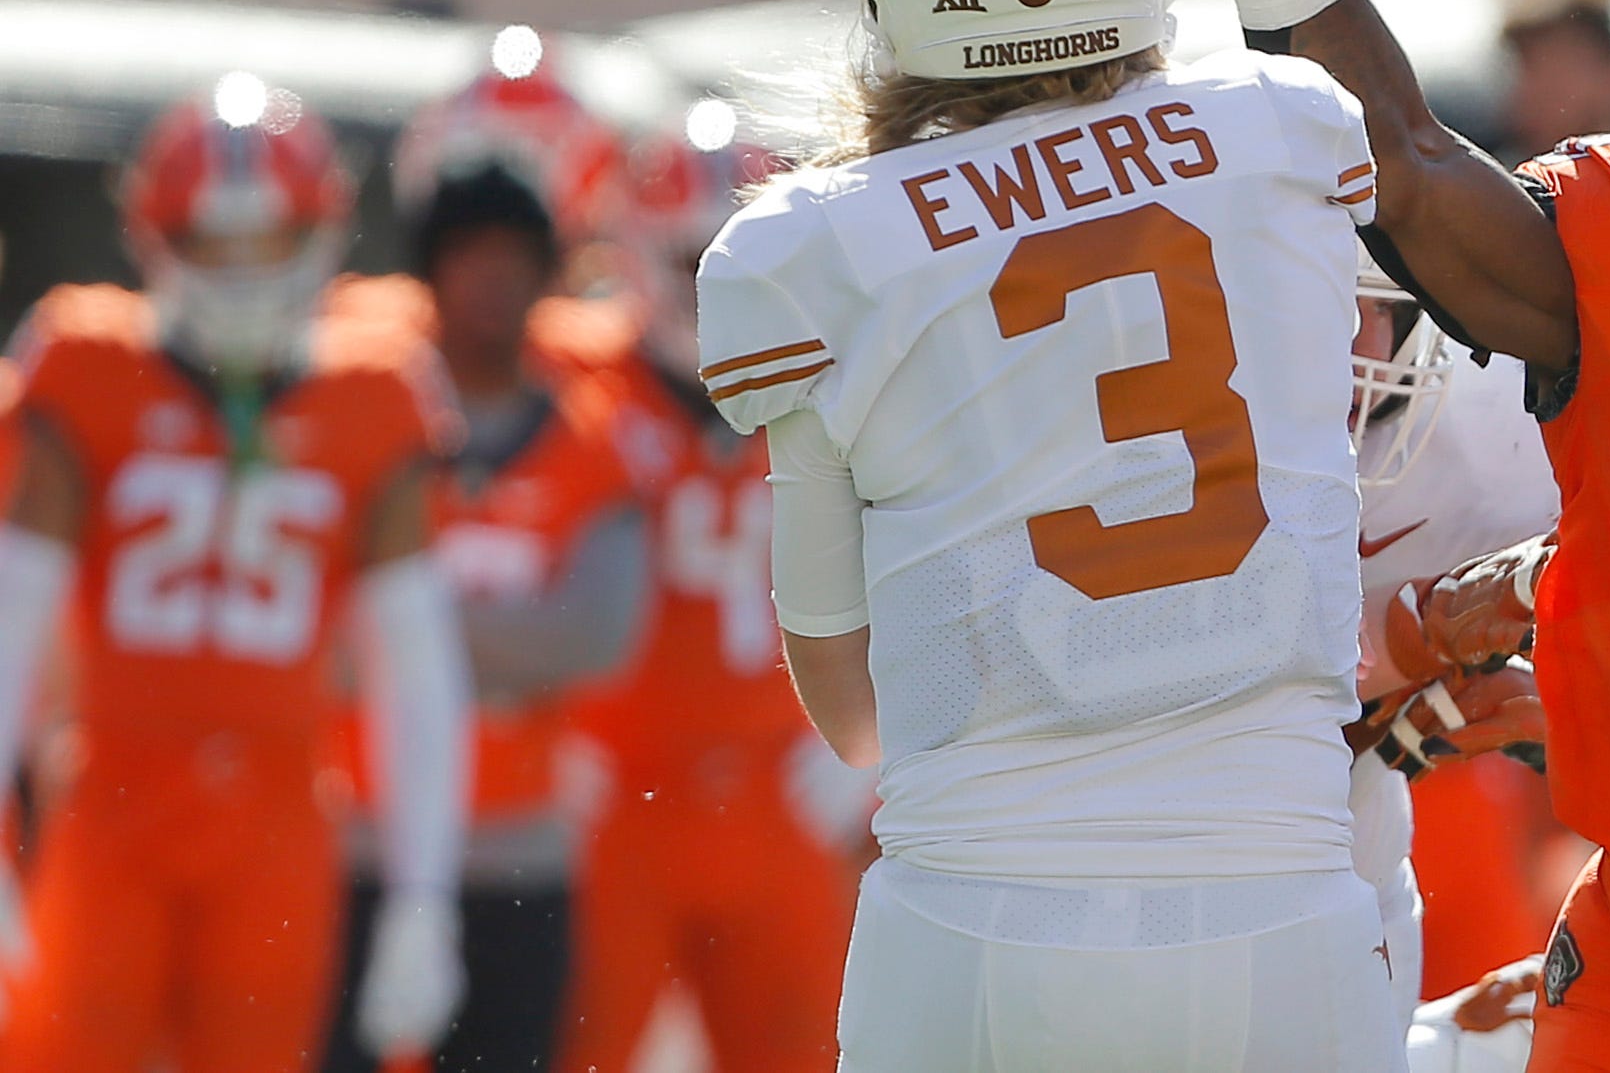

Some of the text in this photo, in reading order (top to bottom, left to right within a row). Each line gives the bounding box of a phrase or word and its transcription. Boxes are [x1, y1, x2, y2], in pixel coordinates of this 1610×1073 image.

[963, 27, 1120, 70] LONGHORNS
[900, 101, 1220, 252] EWERS
[989, 201, 1271, 601] 3
[103, 451, 346, 665] 25
